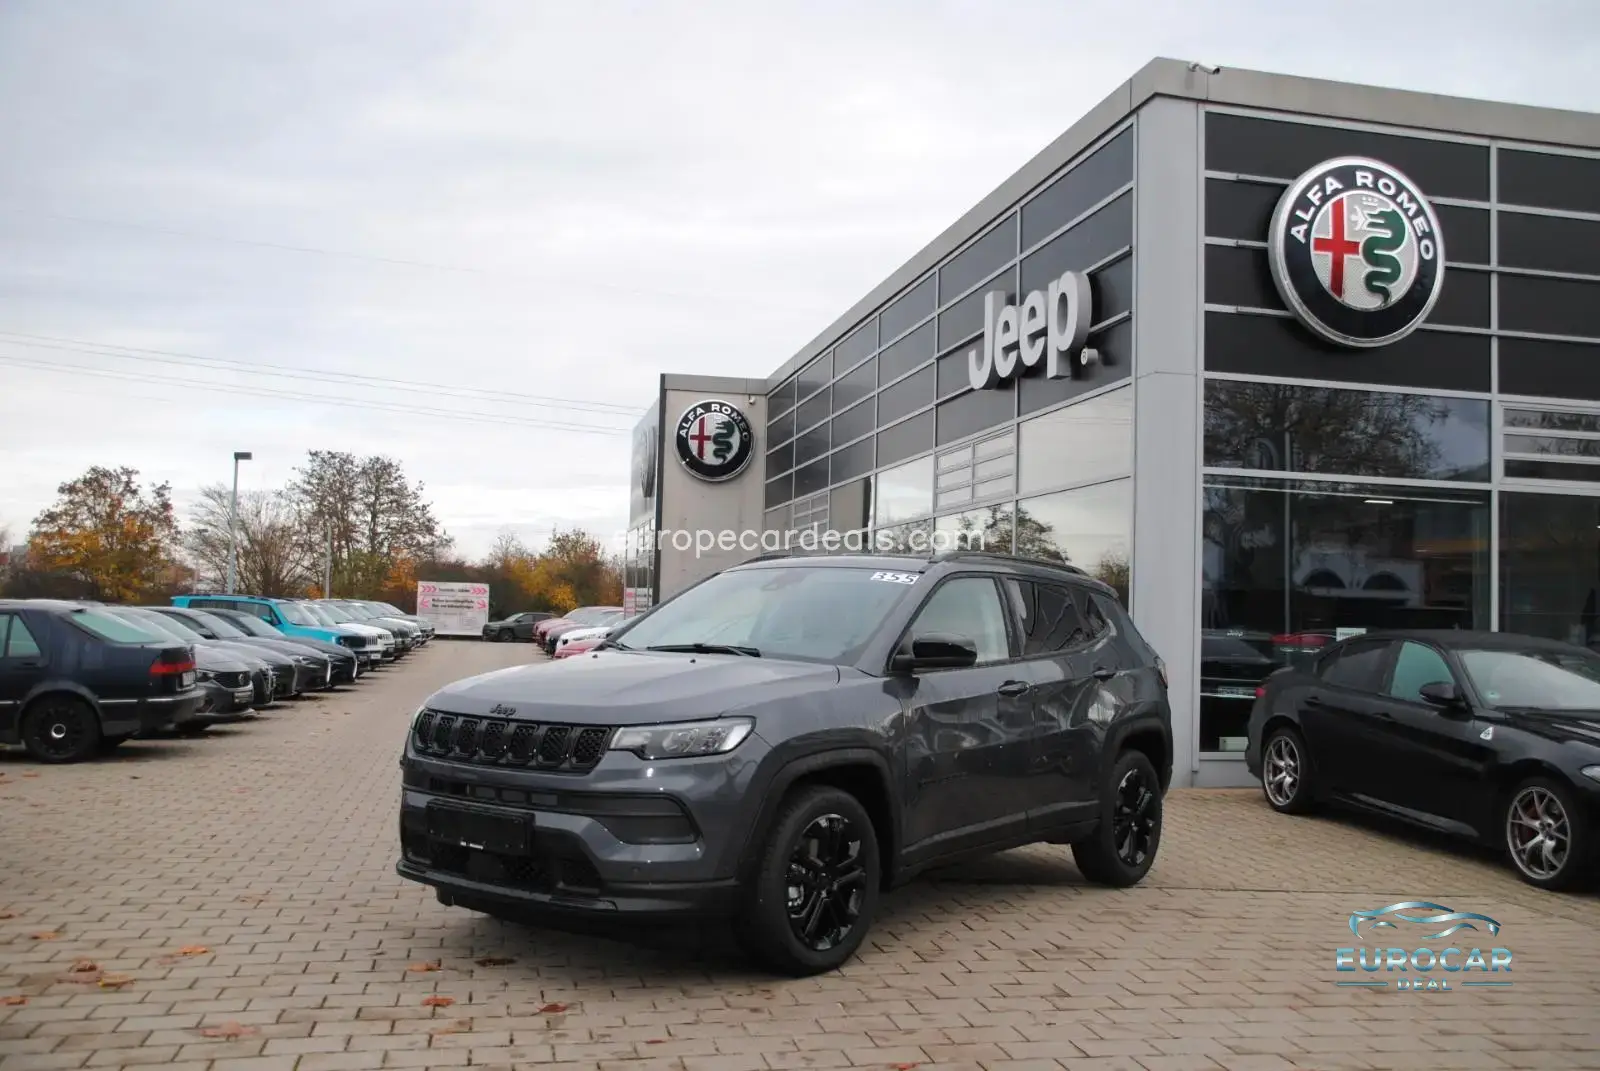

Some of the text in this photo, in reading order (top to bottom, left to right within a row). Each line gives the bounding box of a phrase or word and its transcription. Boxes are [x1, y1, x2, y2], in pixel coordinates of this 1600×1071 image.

[1291, 170, 1434, 260] ALFA ROMEO
[968, 271, 1092, 390] Jeep
[679, 403, 749, 441] ALFA ROMEO
[490, 703, 517, 717] Jeep
